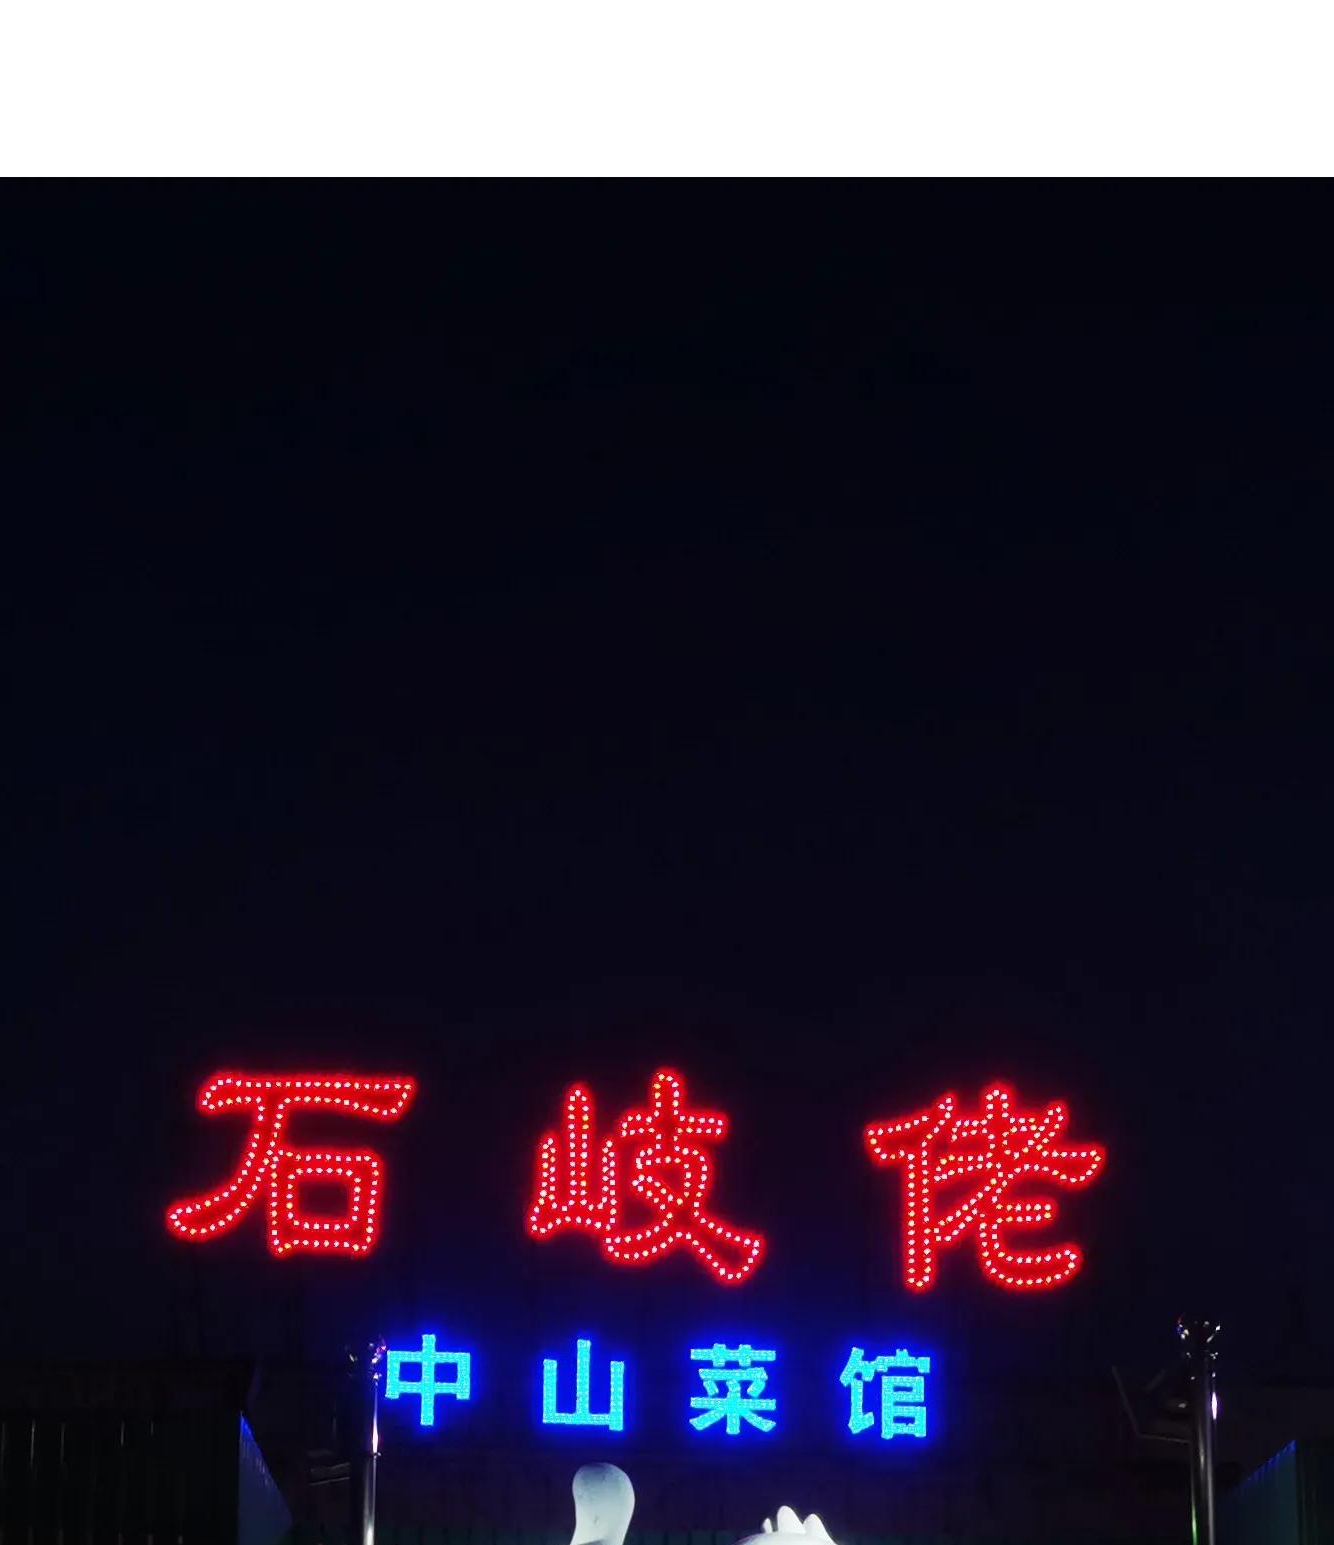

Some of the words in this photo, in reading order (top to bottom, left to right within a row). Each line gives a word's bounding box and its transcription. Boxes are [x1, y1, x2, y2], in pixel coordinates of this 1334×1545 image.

[167, 1070, 1106, 1289] 石岐佬
[385, 1333, 930, 1438] 中山菜馆
